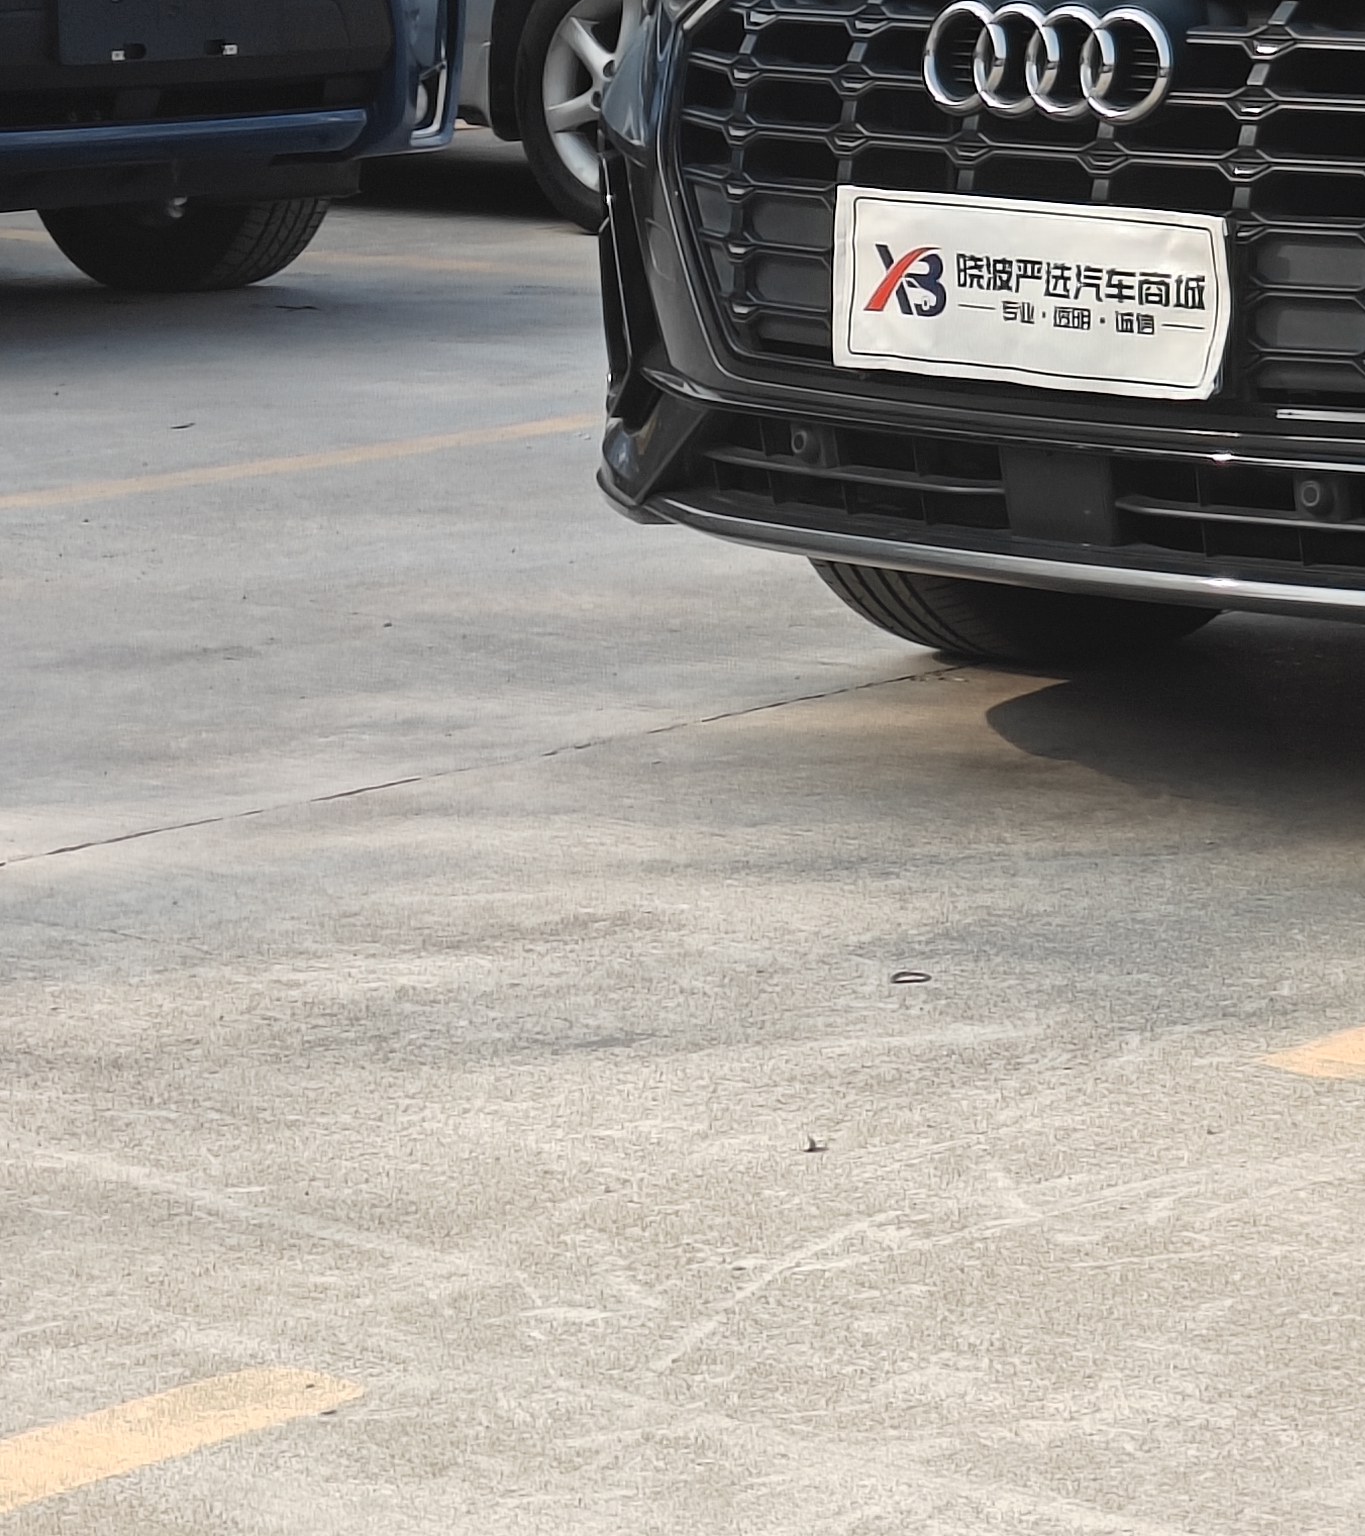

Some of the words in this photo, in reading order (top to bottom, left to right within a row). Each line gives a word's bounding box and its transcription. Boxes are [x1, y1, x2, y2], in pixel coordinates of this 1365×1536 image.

[956, 252, 1206, 311] 晓波严选汽车商城
